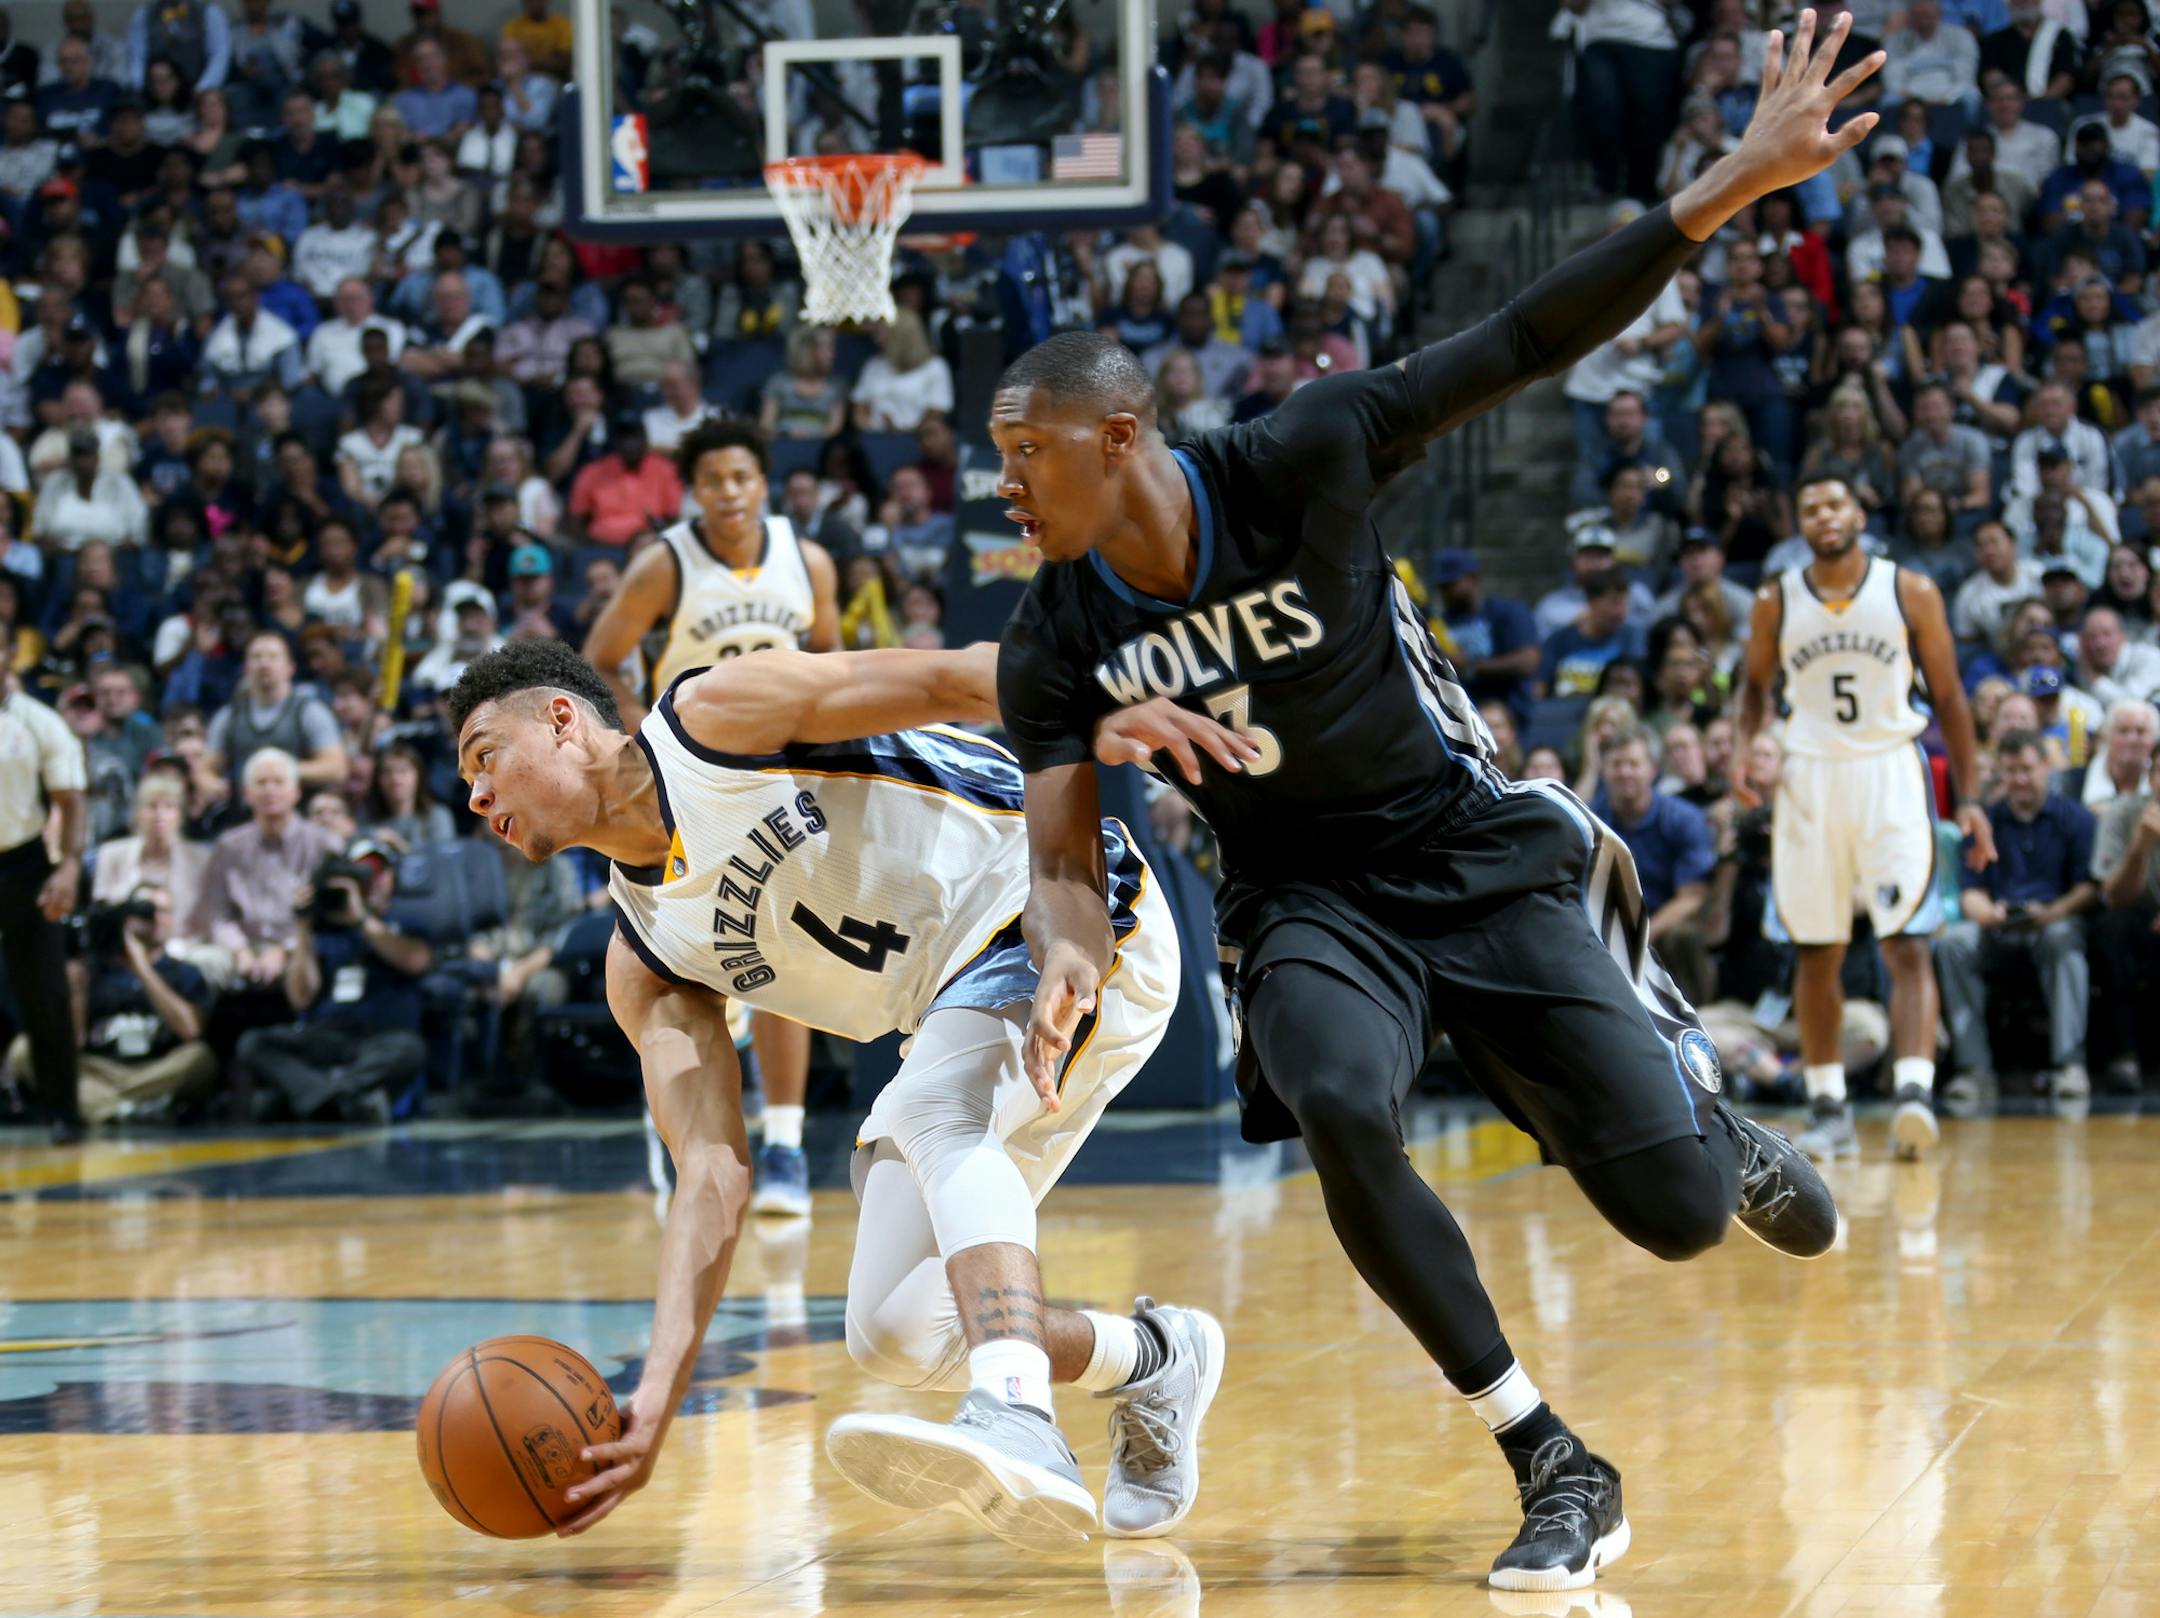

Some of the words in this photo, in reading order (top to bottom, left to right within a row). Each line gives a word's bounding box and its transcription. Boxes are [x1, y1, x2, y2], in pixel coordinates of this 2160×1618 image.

[1095, 576, 1324, 706] WOLVES
[1203, 683, 1284, 777] 3
[1832, 673, 1859, 725] 5
[713, 789, 828, 993] GRIZZLIES
[790, 900, 911, 973] 4
